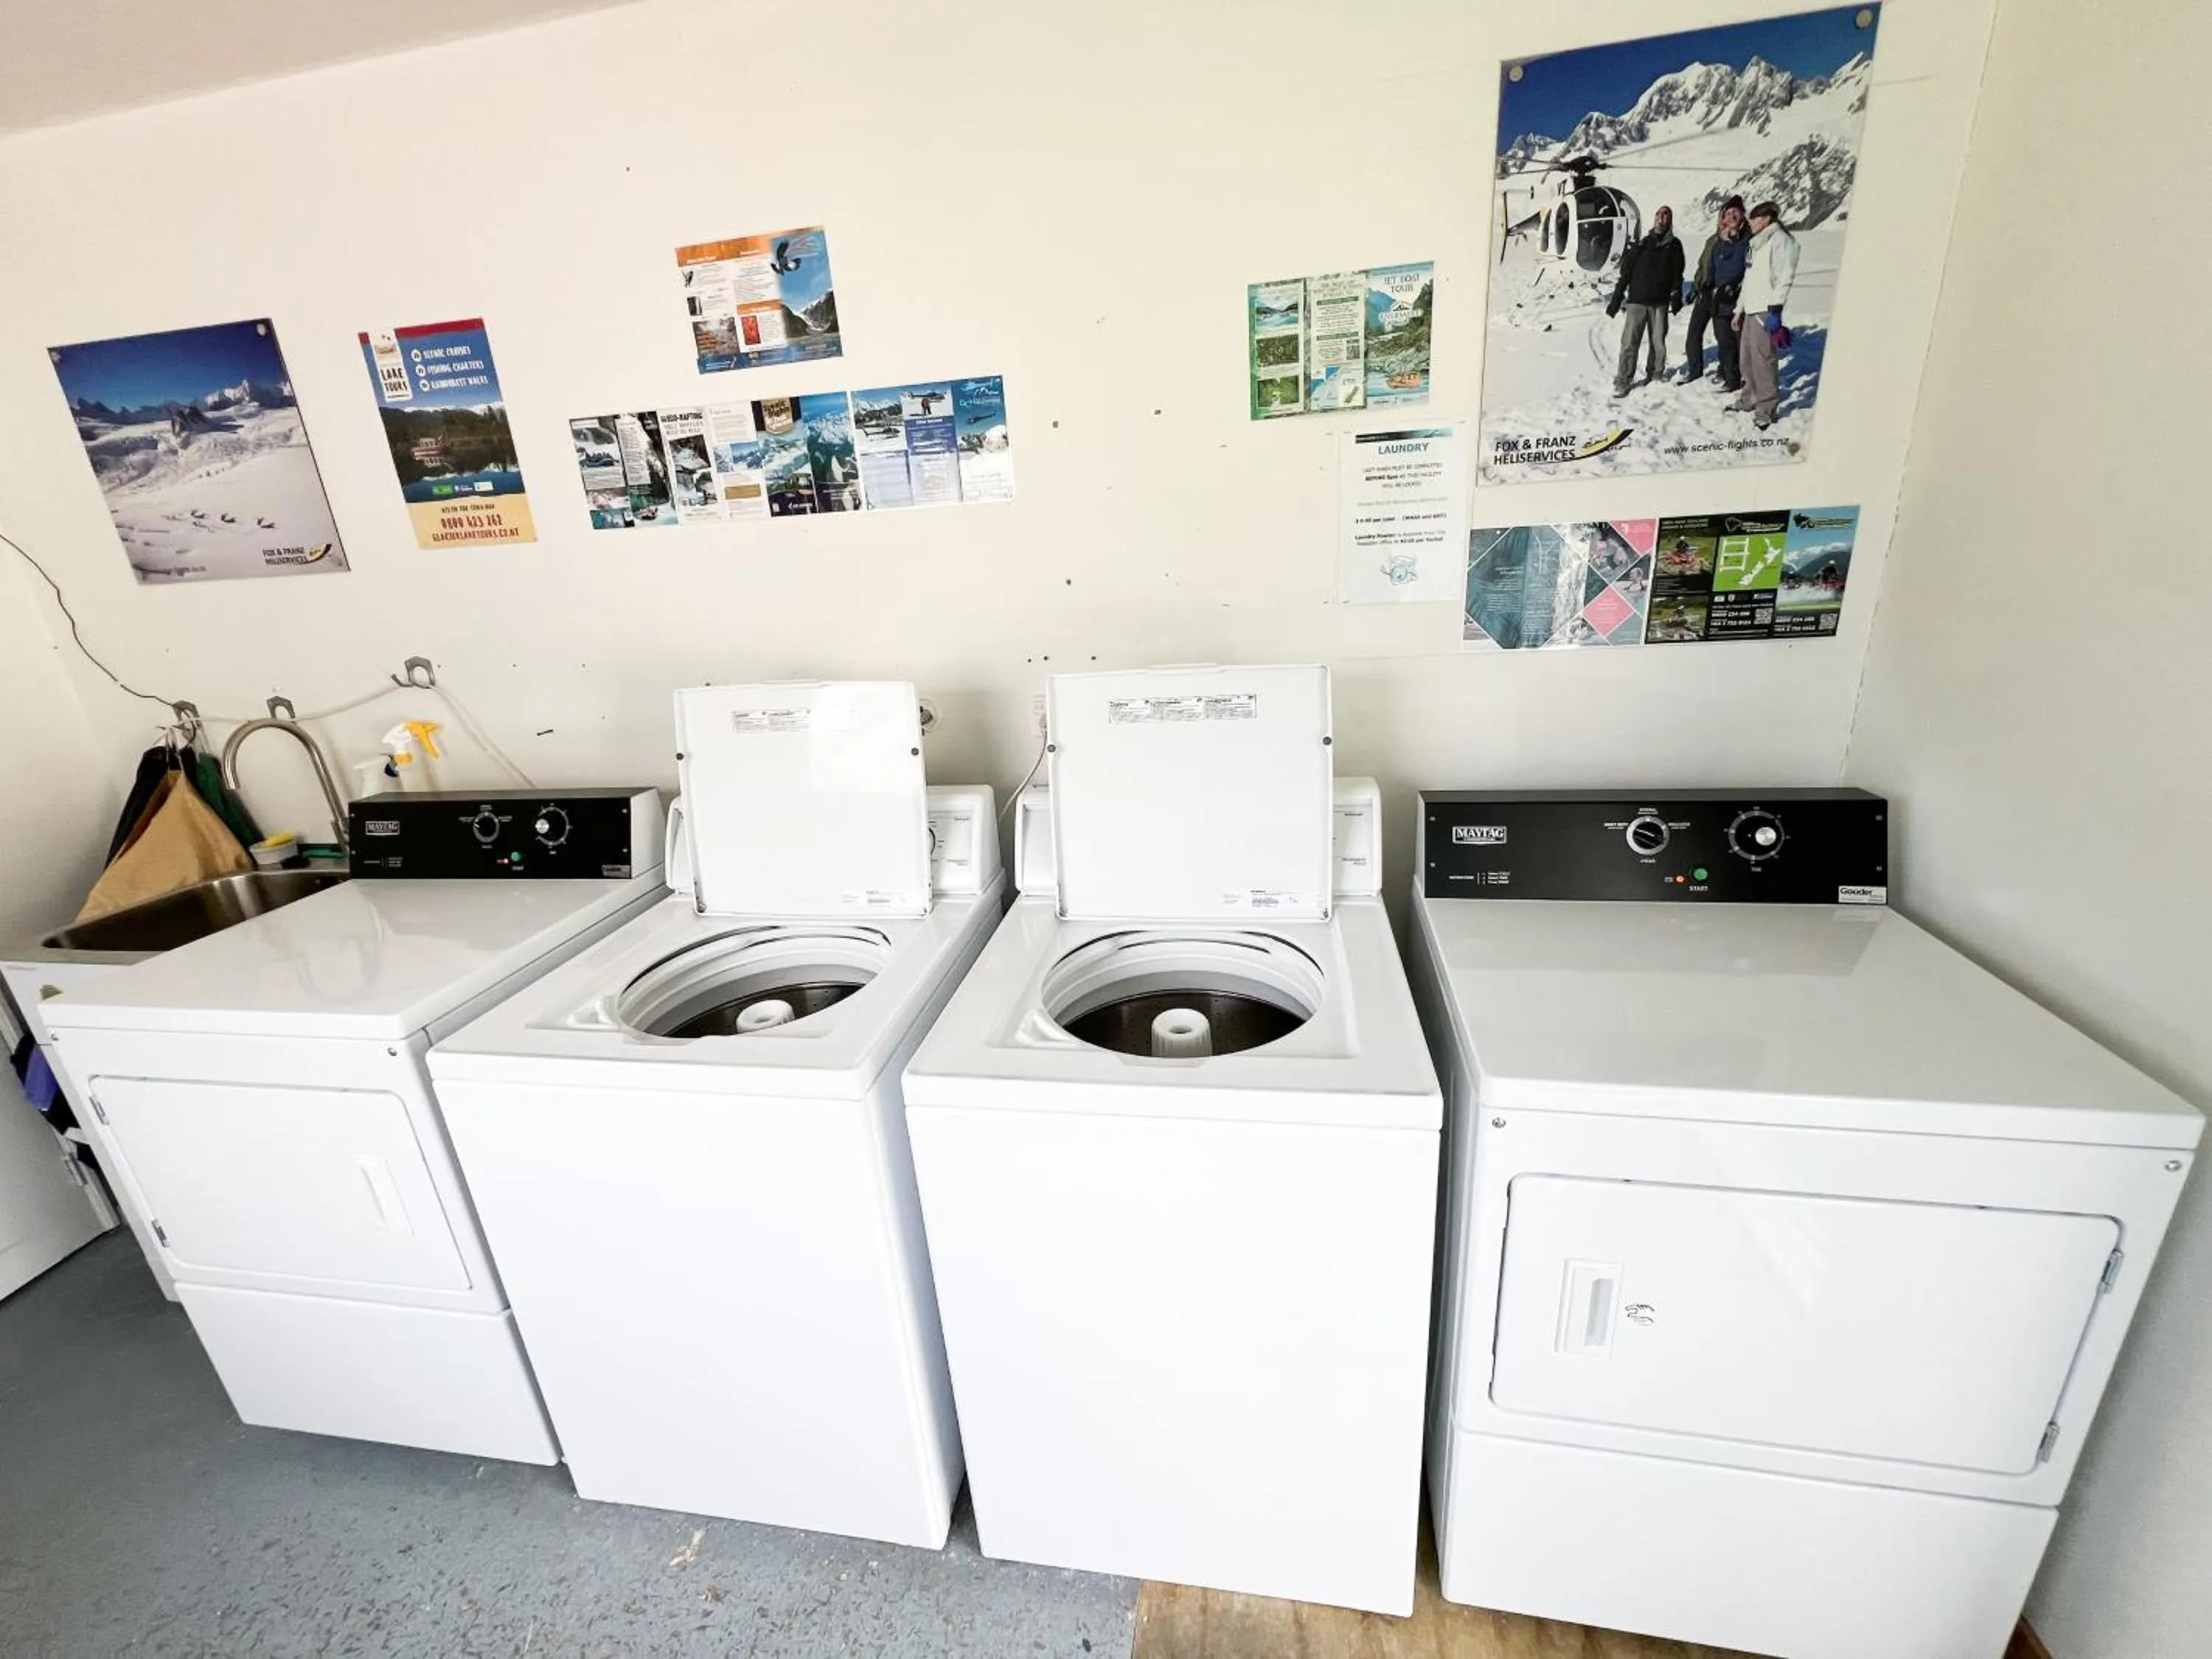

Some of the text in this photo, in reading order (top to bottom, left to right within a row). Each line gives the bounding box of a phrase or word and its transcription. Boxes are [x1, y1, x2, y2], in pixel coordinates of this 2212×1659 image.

[380, 368, 404, 380] LAKE
[384, 381, 408, 392] TOURS
[1377, 442, 1429, 455] LAUNDRY
[1495, 436, 1576, 453] FOX & FRANZ
[1493, 449, 1576, 465] HELISERVICES
[1455, 827, 1504, 838] MAYTAG
